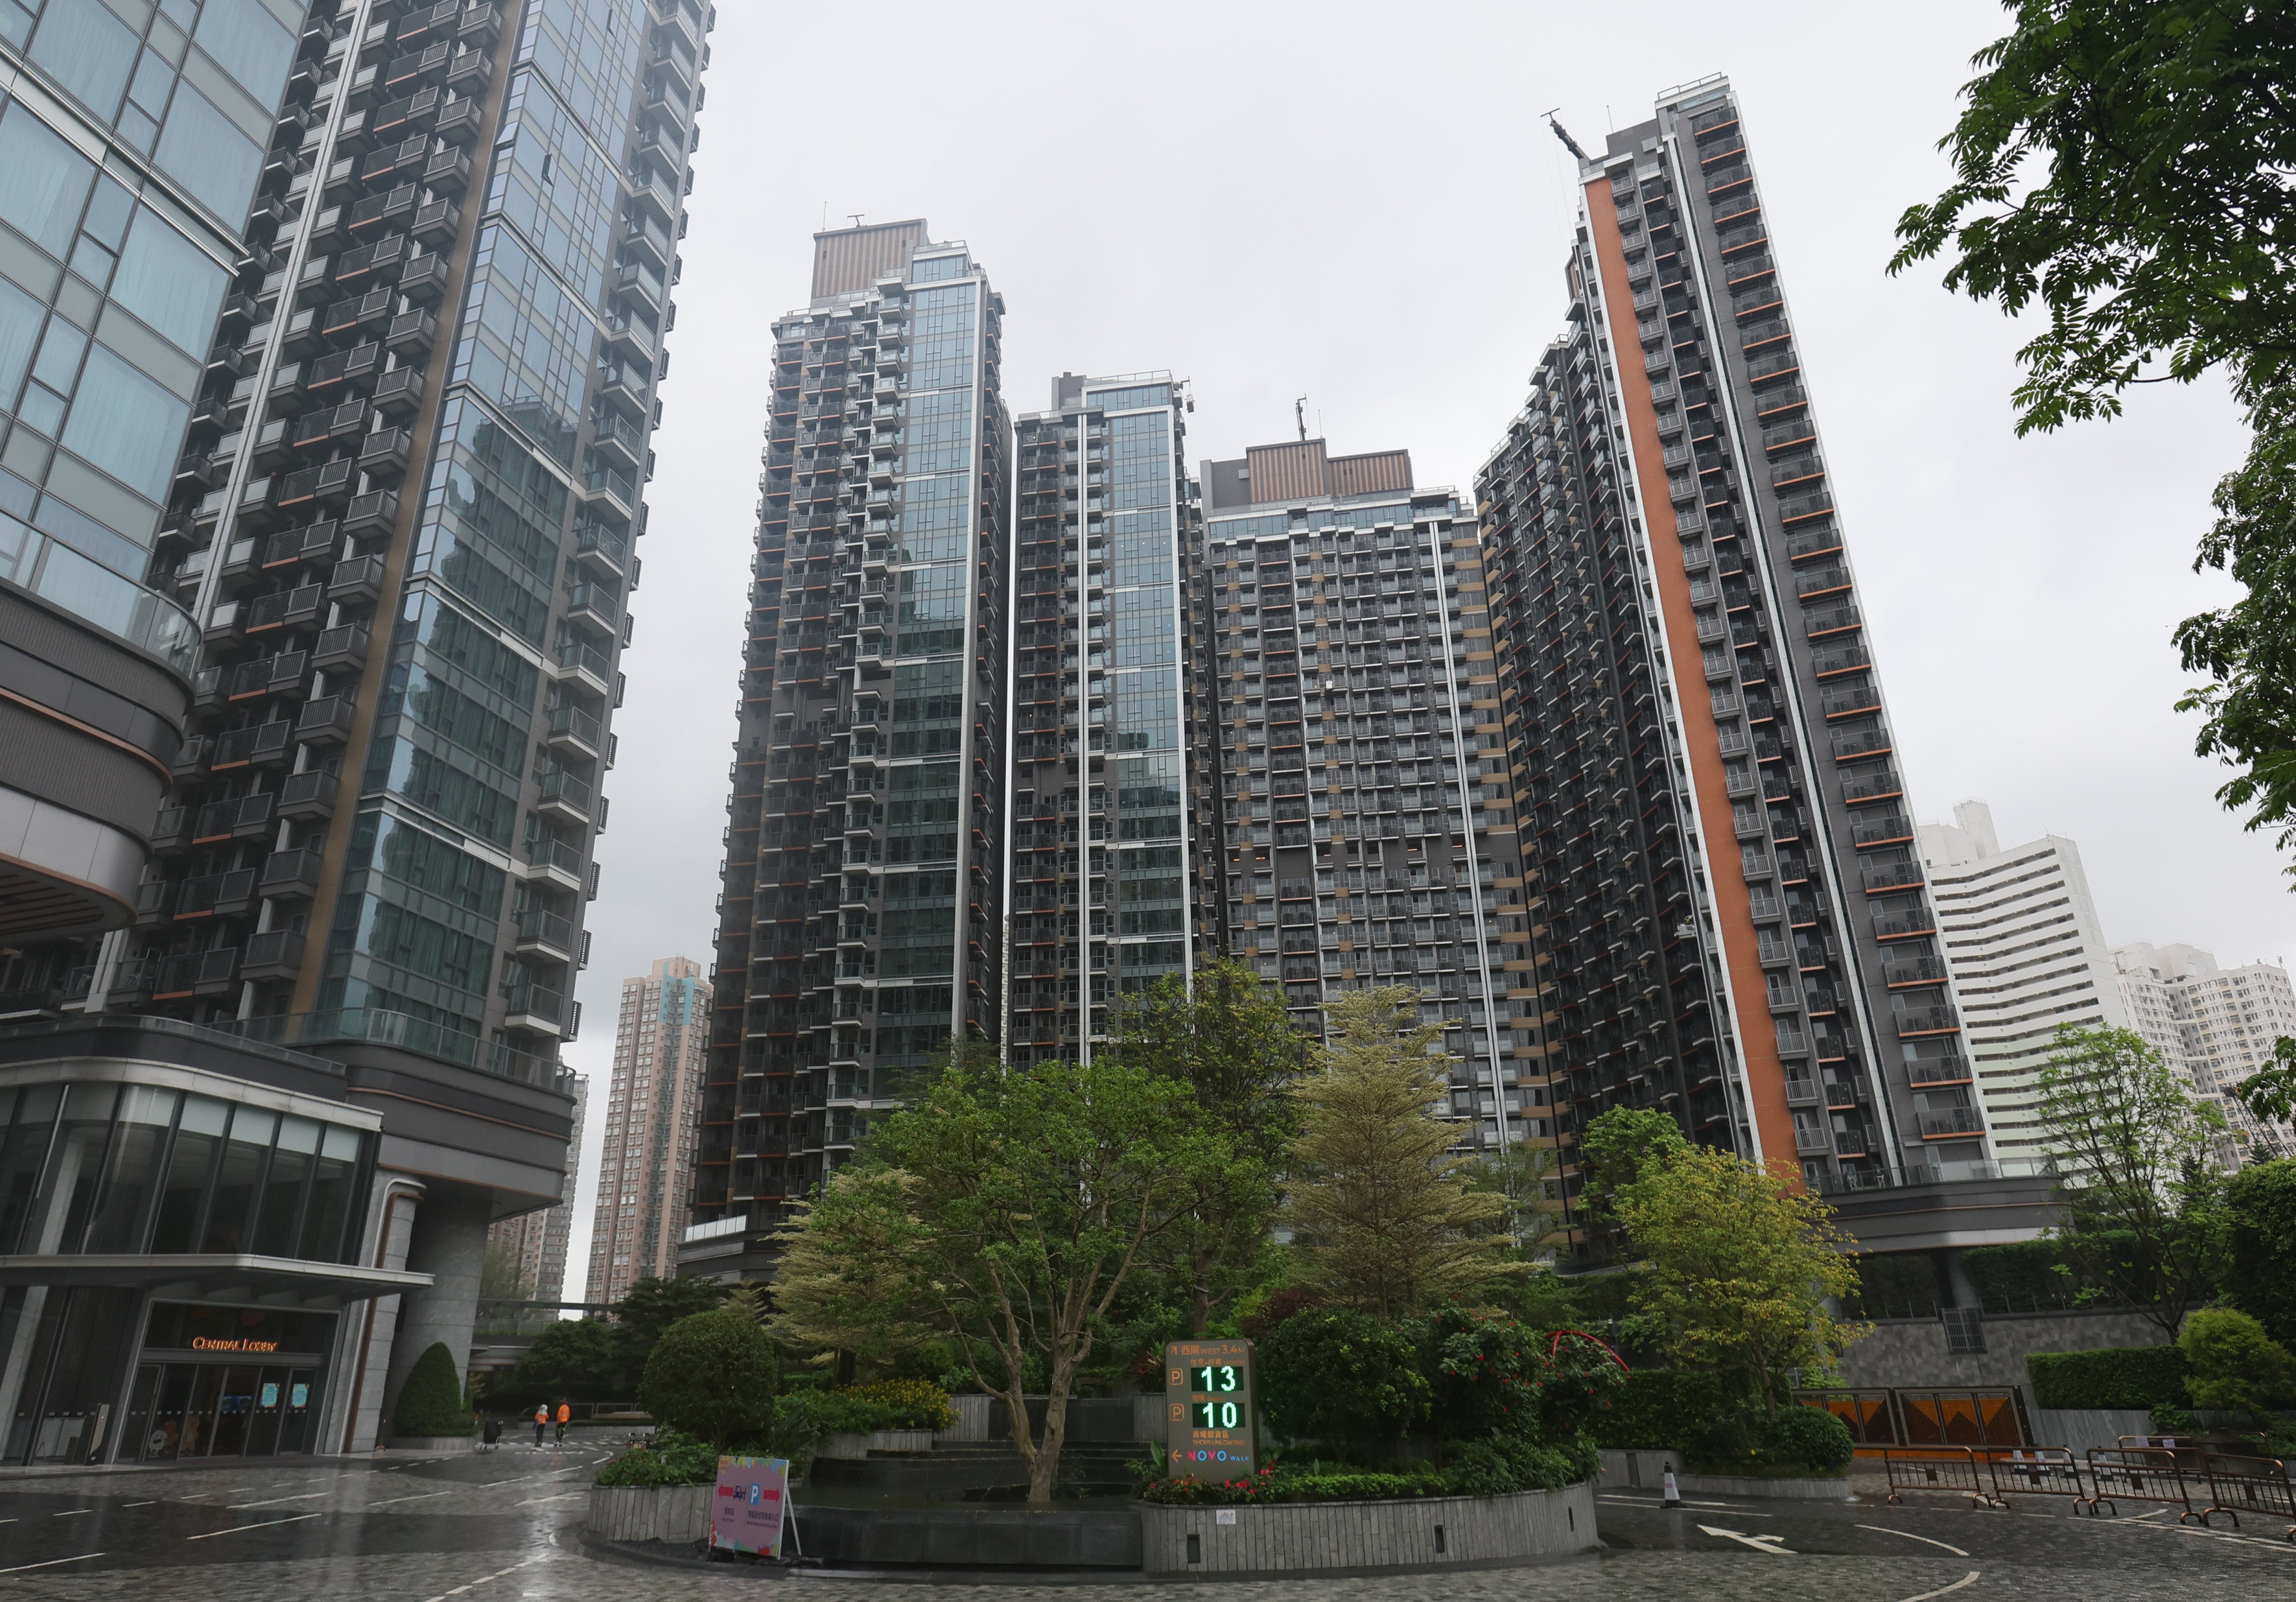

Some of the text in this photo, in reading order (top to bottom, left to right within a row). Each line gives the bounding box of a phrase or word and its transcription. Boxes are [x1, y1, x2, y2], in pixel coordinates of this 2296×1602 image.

[193, 1336, 279, 1352] CENTRAL LOBBY
[1201, 1366, 1236, 1392] 13
[1203, 1402, 1237, 1428] 10
[1187, 1450, 1227, 1461] NOVO
